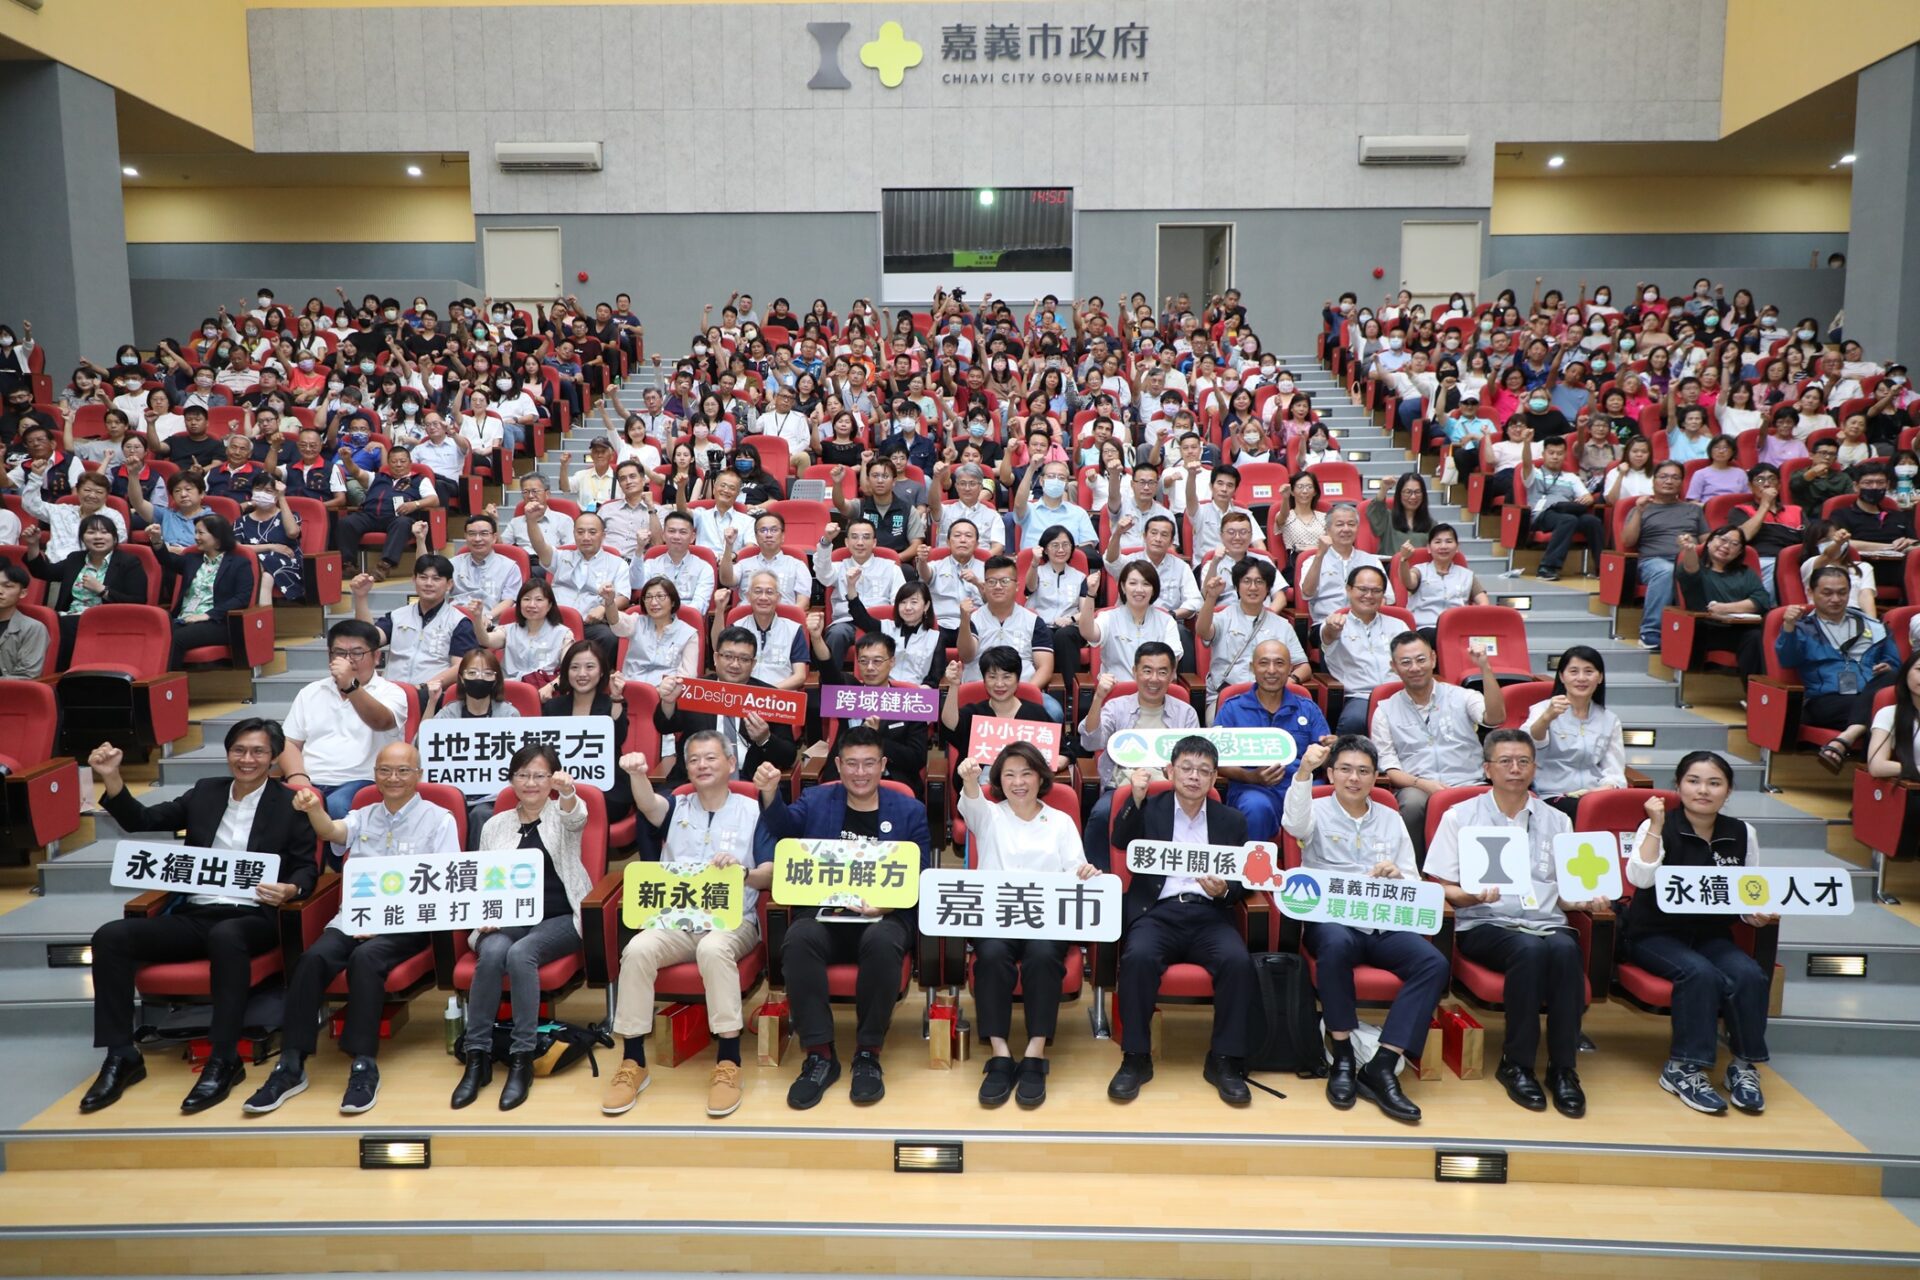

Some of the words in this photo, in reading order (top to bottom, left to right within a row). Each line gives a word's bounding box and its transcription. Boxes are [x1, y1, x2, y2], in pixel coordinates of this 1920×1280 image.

[941, 22, 1150, 60] 嘉義市政府
[942, 73, 994, 83] CHIAYI
[1002, 73, 1035, 83] CITY
[1042, 72, 1150, 83] GOVERNMENT
[835, 690, 933, 714] 跨域鏈結
[976, 721, 1053, 744] 小小行為
[428, 767, 492, 783] EARTH
[126, 850, 266, 890] 永續出擊
[786, 858, 909, 888] 城市解方
[1133, 846, 1237, 875] 夥伴關係
[409, 860, 479, 895] 永續
[1328, 877, 1417, 903] 嘉義市政府
[1664, 874, 1731, 907] 永續
[1780, 876, 1844, 908] 人才
[638, 881, 731, 910] 新永續
[936, 880, 1105, 930] 嘉義市
[1326, 897, 1438, 930] 環境保護局
